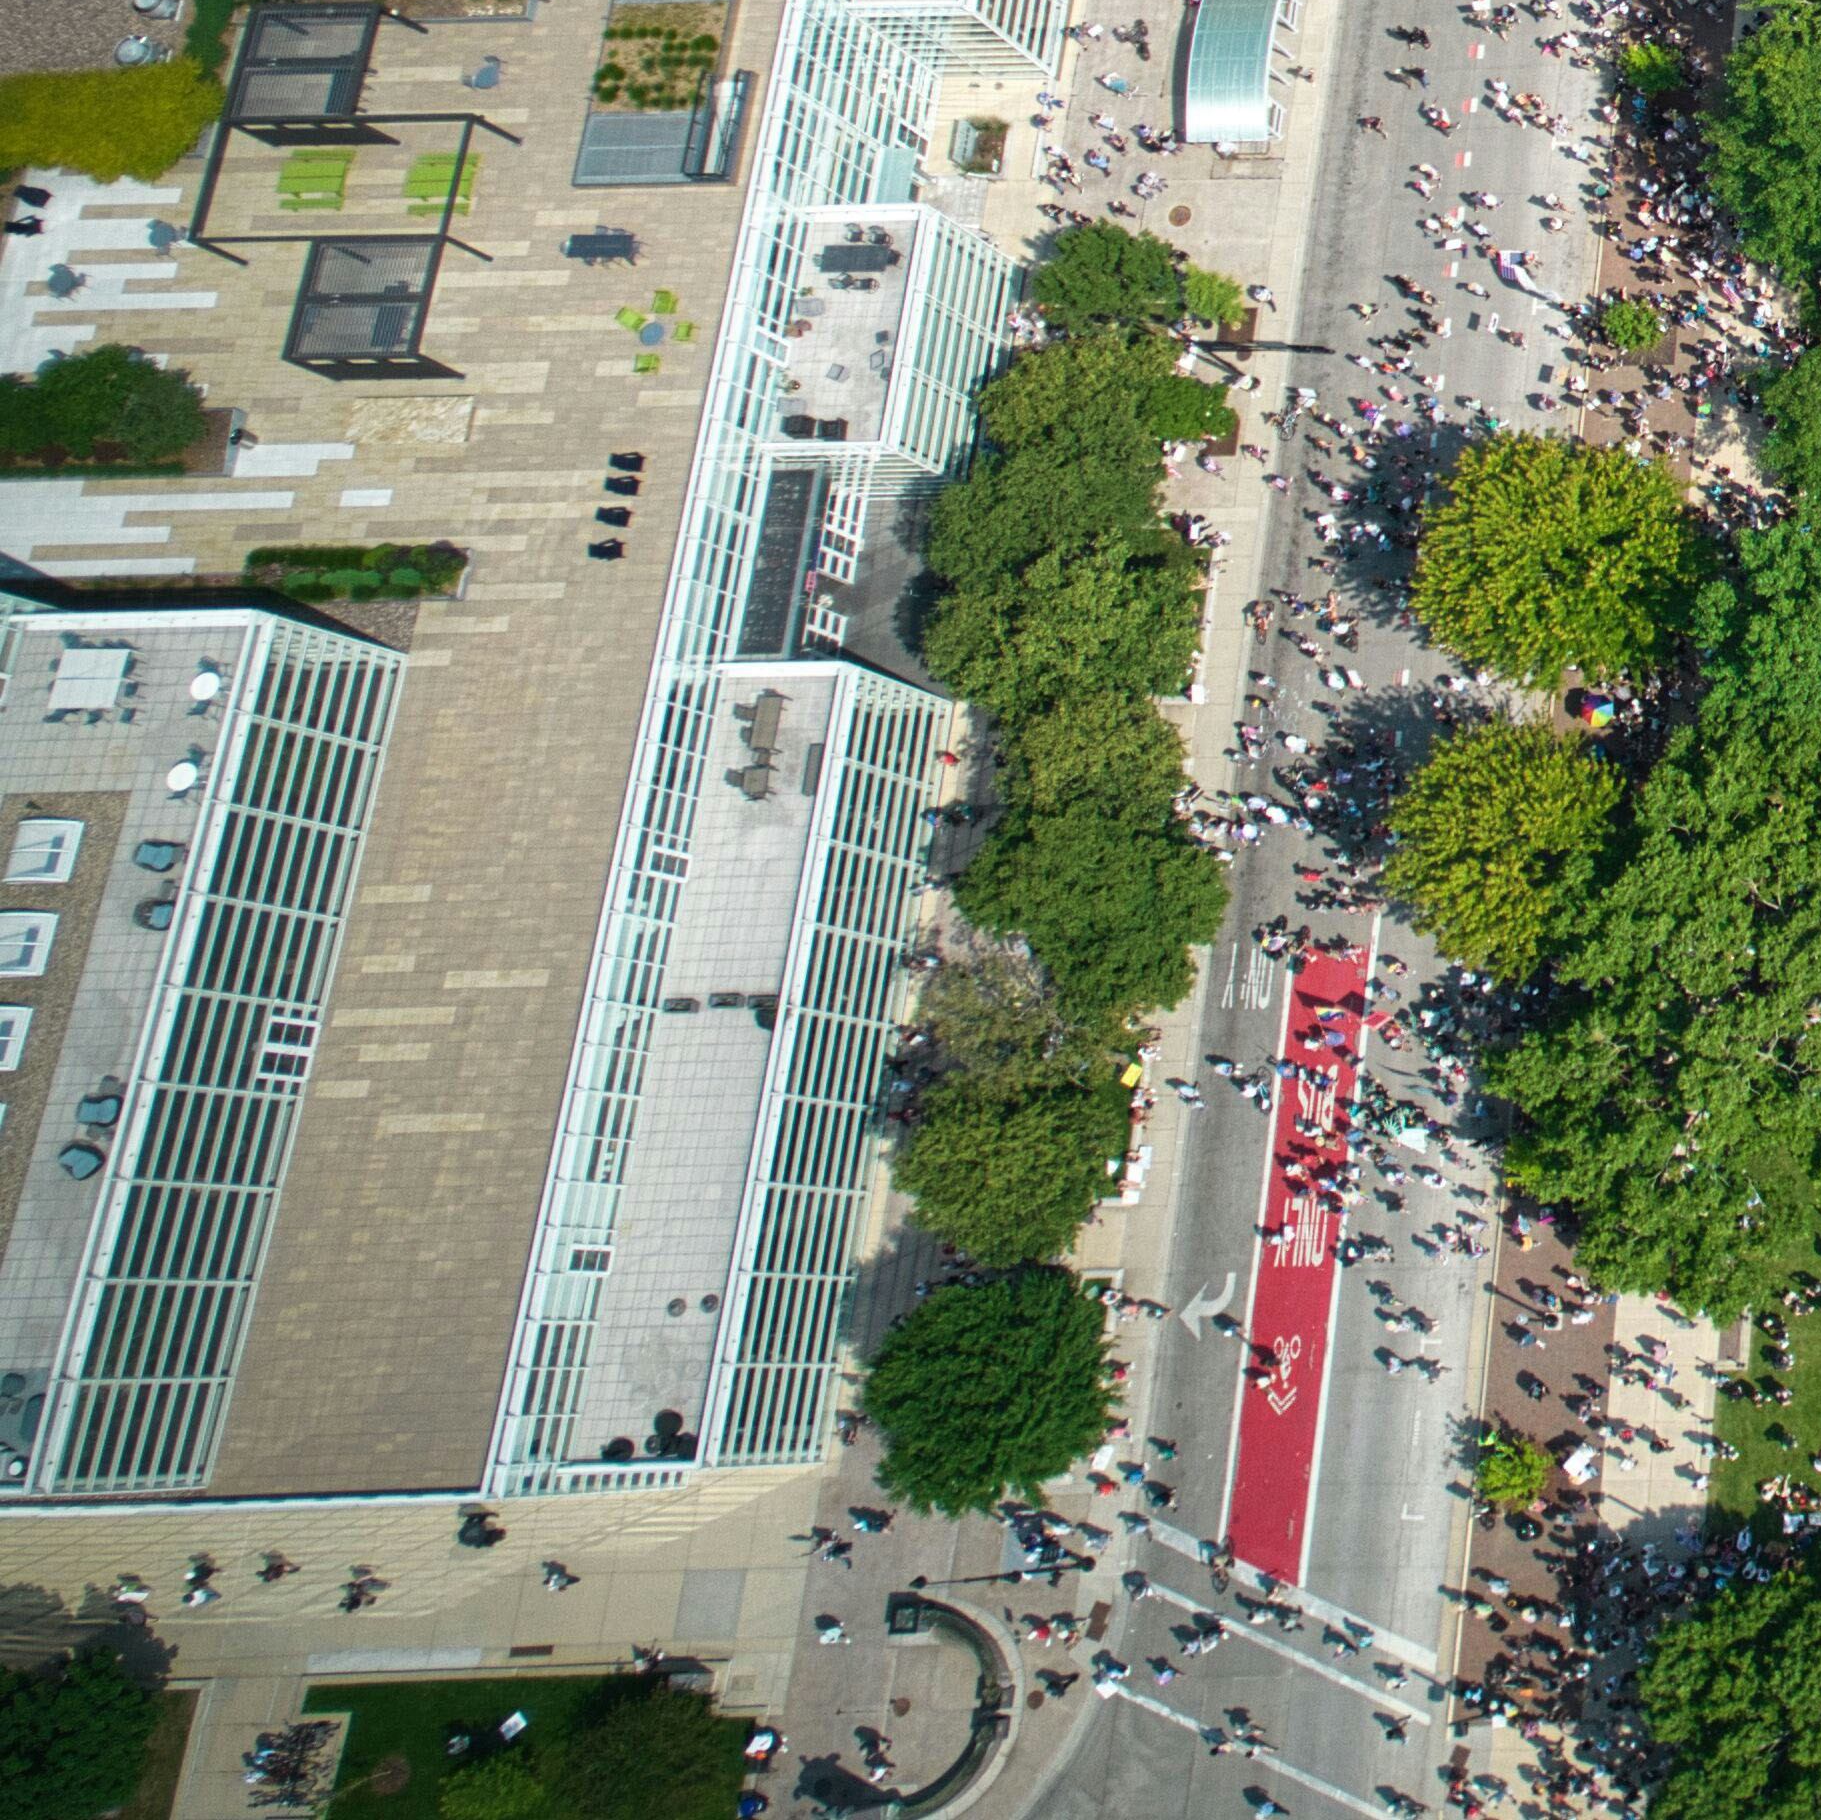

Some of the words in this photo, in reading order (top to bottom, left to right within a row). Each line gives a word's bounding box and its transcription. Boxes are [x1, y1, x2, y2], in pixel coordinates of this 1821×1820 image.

[1221, 942, 1275, 1010] ONY
[1297, 1063, 1339, 1133] BUS
[1273, 1197, 1329, 1268] ONLY
